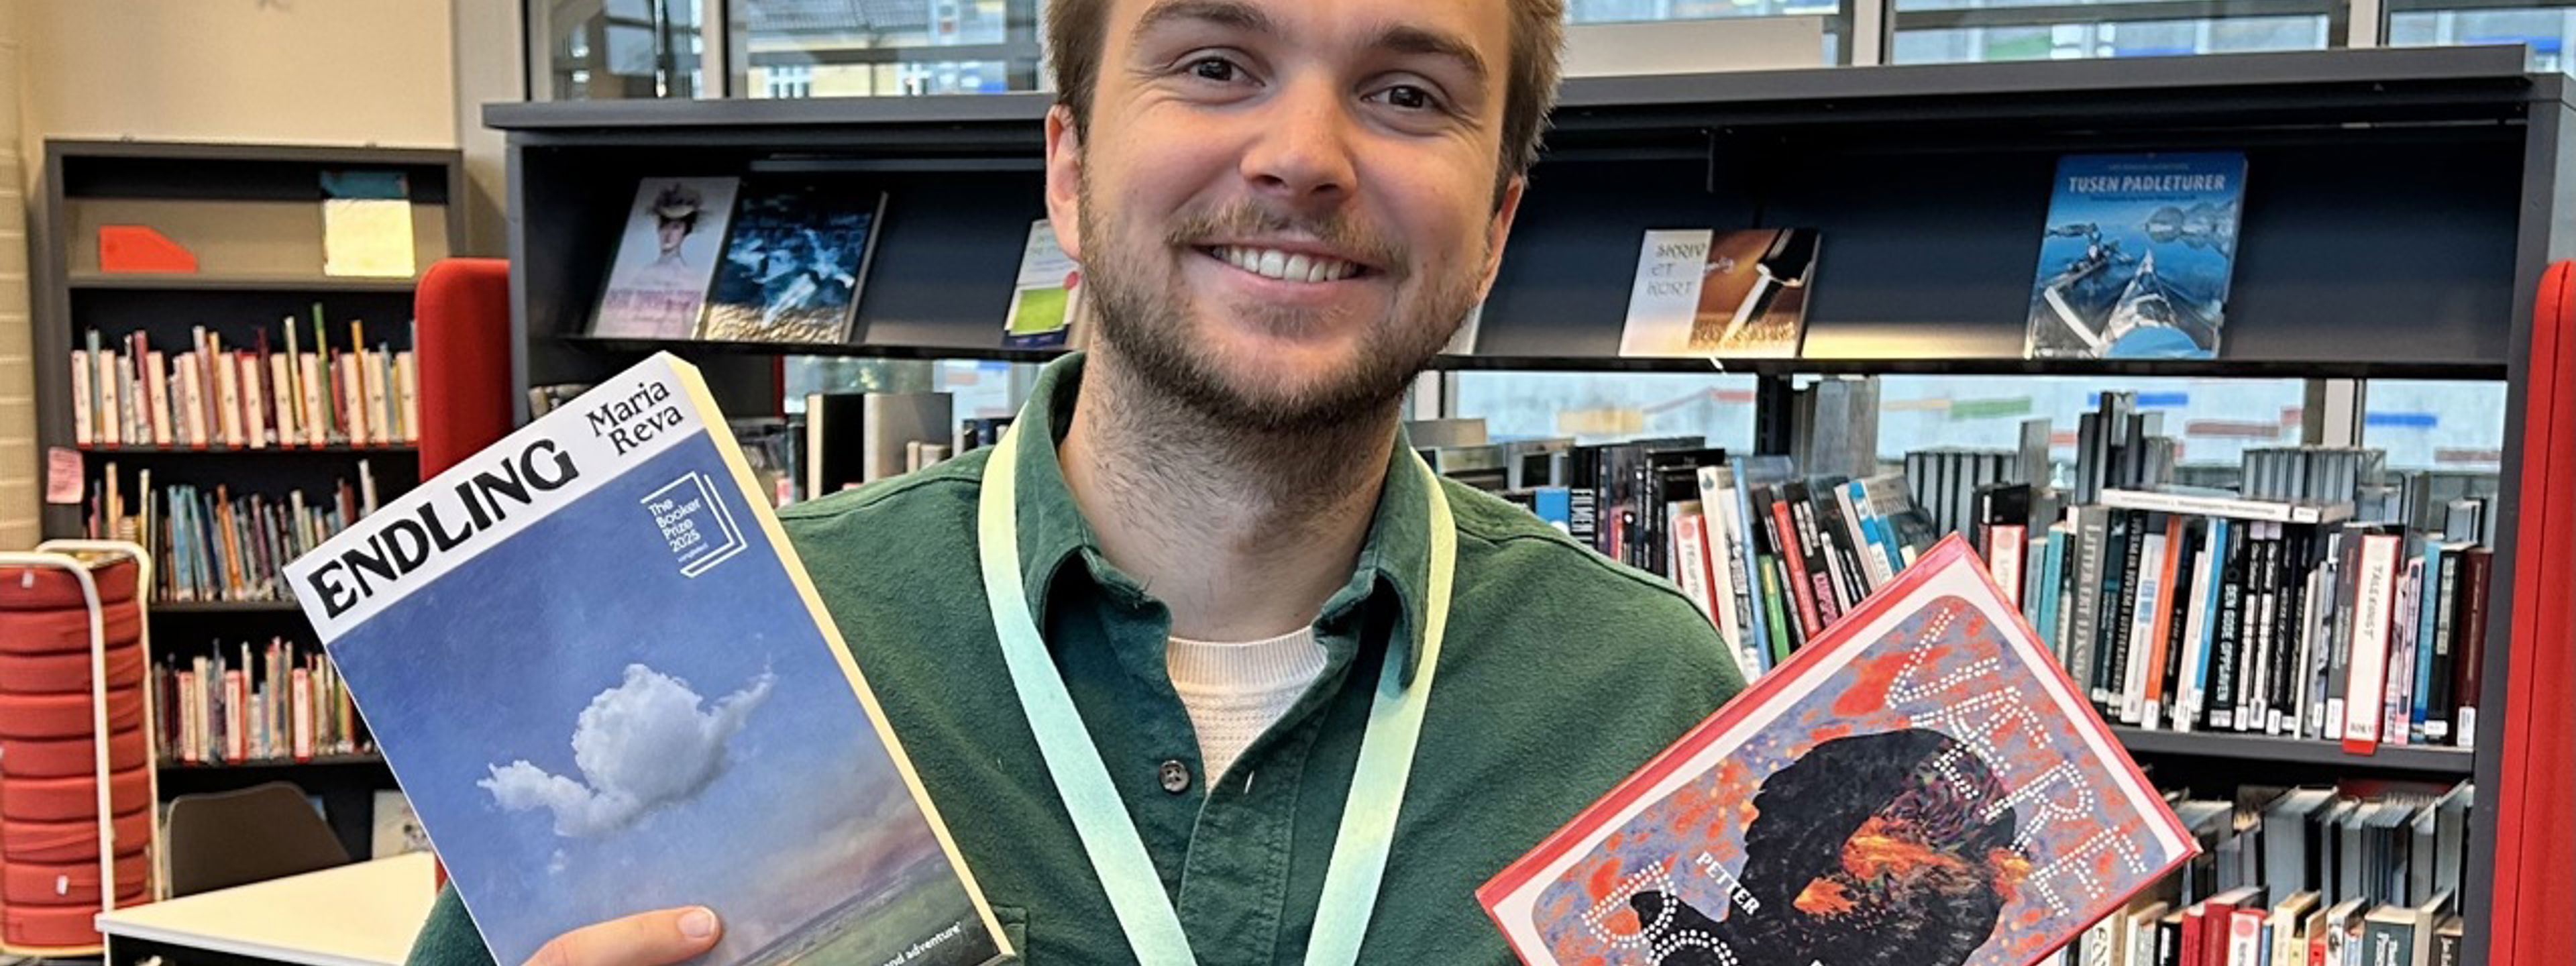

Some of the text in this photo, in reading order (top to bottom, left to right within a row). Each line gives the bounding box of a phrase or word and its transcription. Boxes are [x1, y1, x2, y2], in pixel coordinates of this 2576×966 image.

[2069, 173, 2226, 193] TUSEN PADLETURER
[584, 378, 671, 438] Maria
[607, 405, 684, 457] Reva
[648, 498, 674, 516] The
[655, 498, 702, 529] Booker
[307, 438, 580, 620] ENDLING
[661, 519, 694, 541] Prize
[669, 529, 702, 553] 2025
[2224, 583, 2238, 608] DEN
[2363, 564, 2383, 641] TALEKUNST
[2216, 641, 2233, 702] OPPGAVEN
[1695, 851, 1762, 916] PETTER
